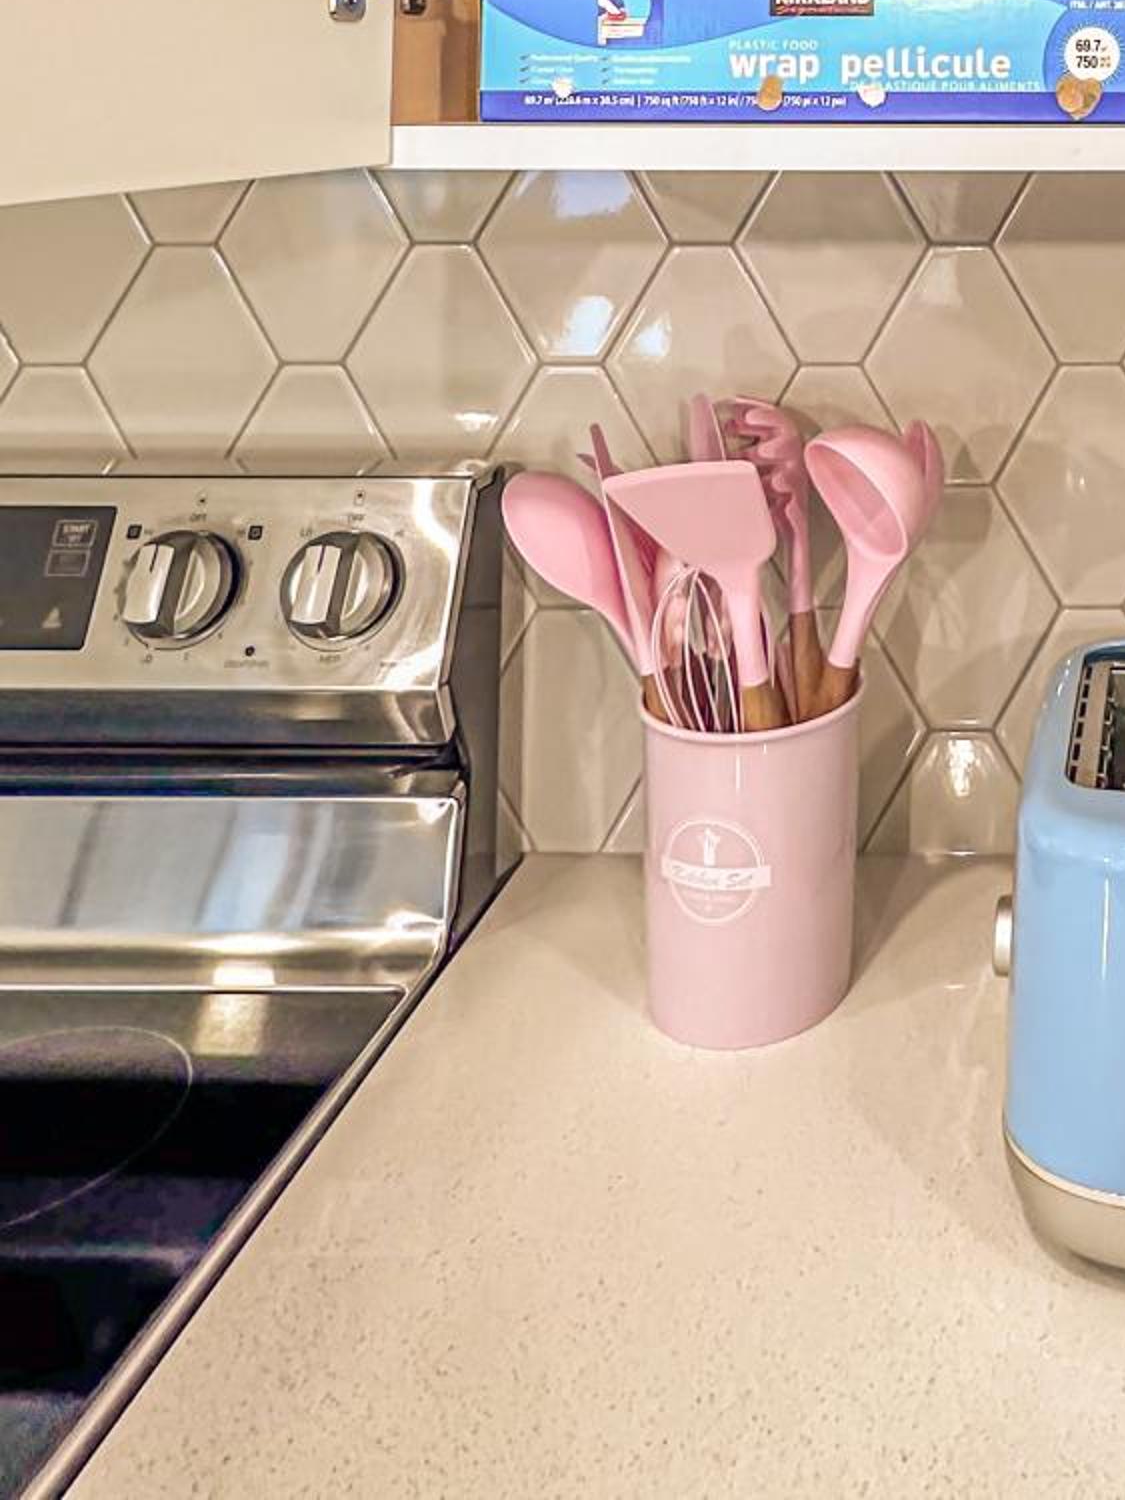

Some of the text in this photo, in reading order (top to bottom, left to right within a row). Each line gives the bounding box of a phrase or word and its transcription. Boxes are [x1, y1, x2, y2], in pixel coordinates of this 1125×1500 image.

[729, 40, 818, 50] PLASTIC FOOD
[1075, 39, 1101, 53] 69.7
[729, 45, 1012, 85] wrap pellicule
[1075, 55, 1099, 69] 750
